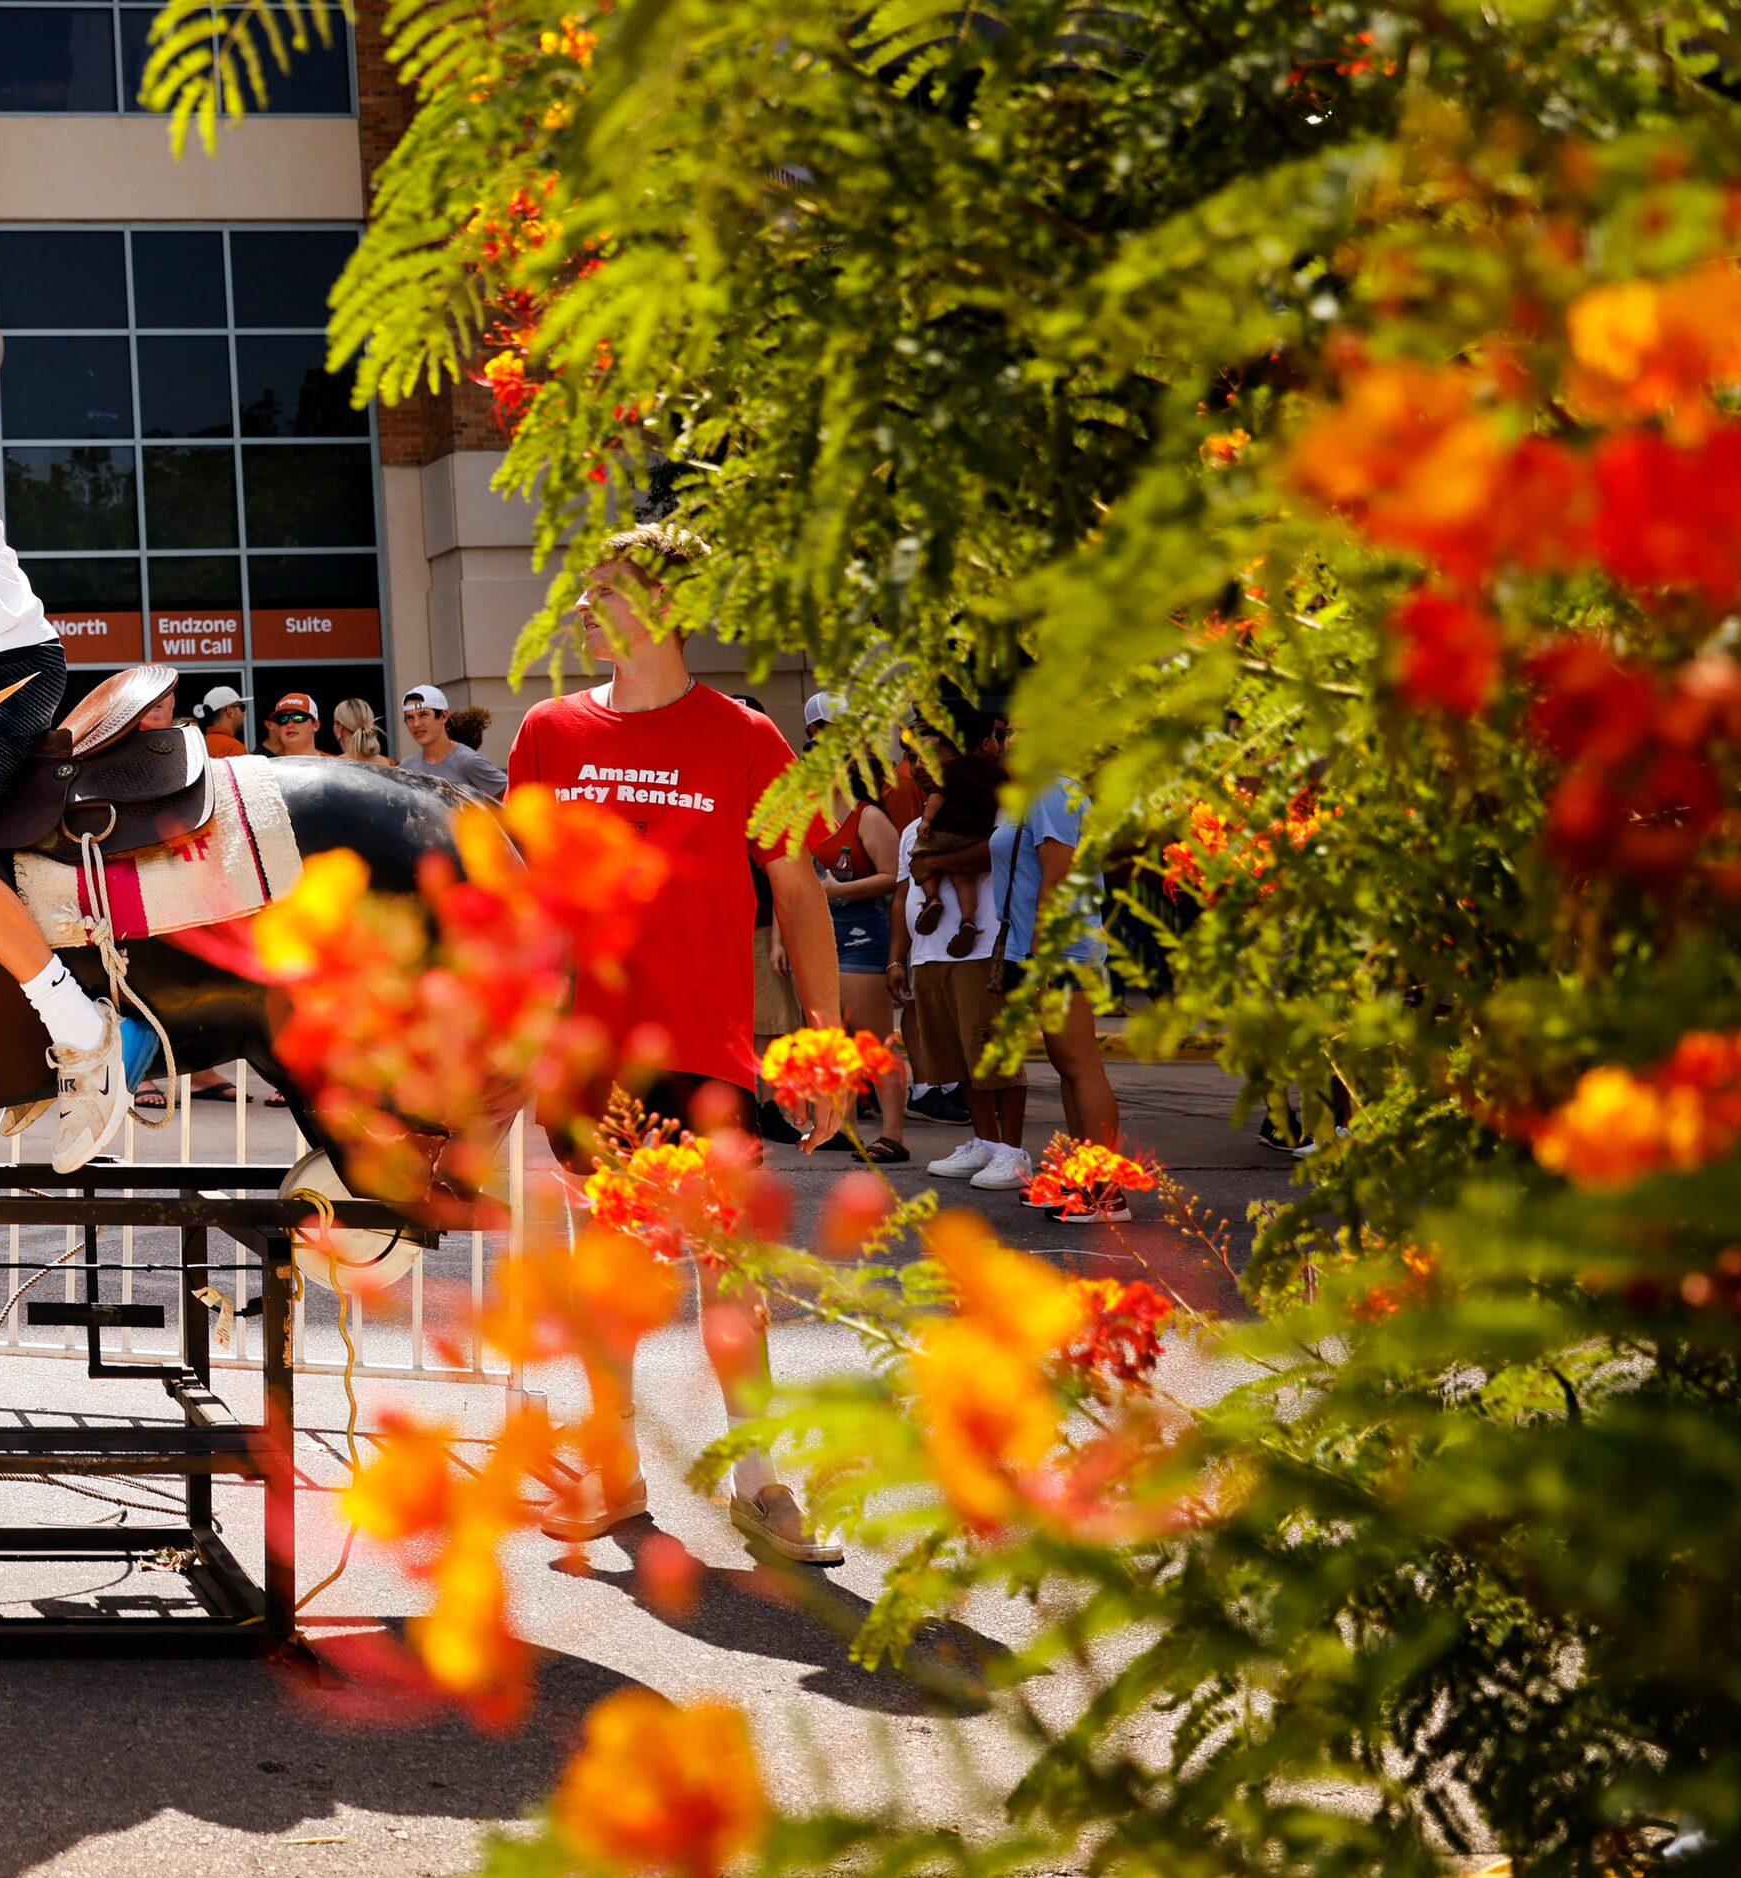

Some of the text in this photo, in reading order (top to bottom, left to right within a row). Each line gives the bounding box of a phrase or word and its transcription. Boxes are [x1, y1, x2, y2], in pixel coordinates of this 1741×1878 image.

[52, 618, 108, 636] North
[158, 617, 237, 634] Endzone
[285, 617, 332, 634] Suite
[162, 638, 232, 656] Will Call
[578, 764, 679, 786] Amanzi
[617, 785, 715, 813] Rentals
[58, 1078, 77, 1093] IR
